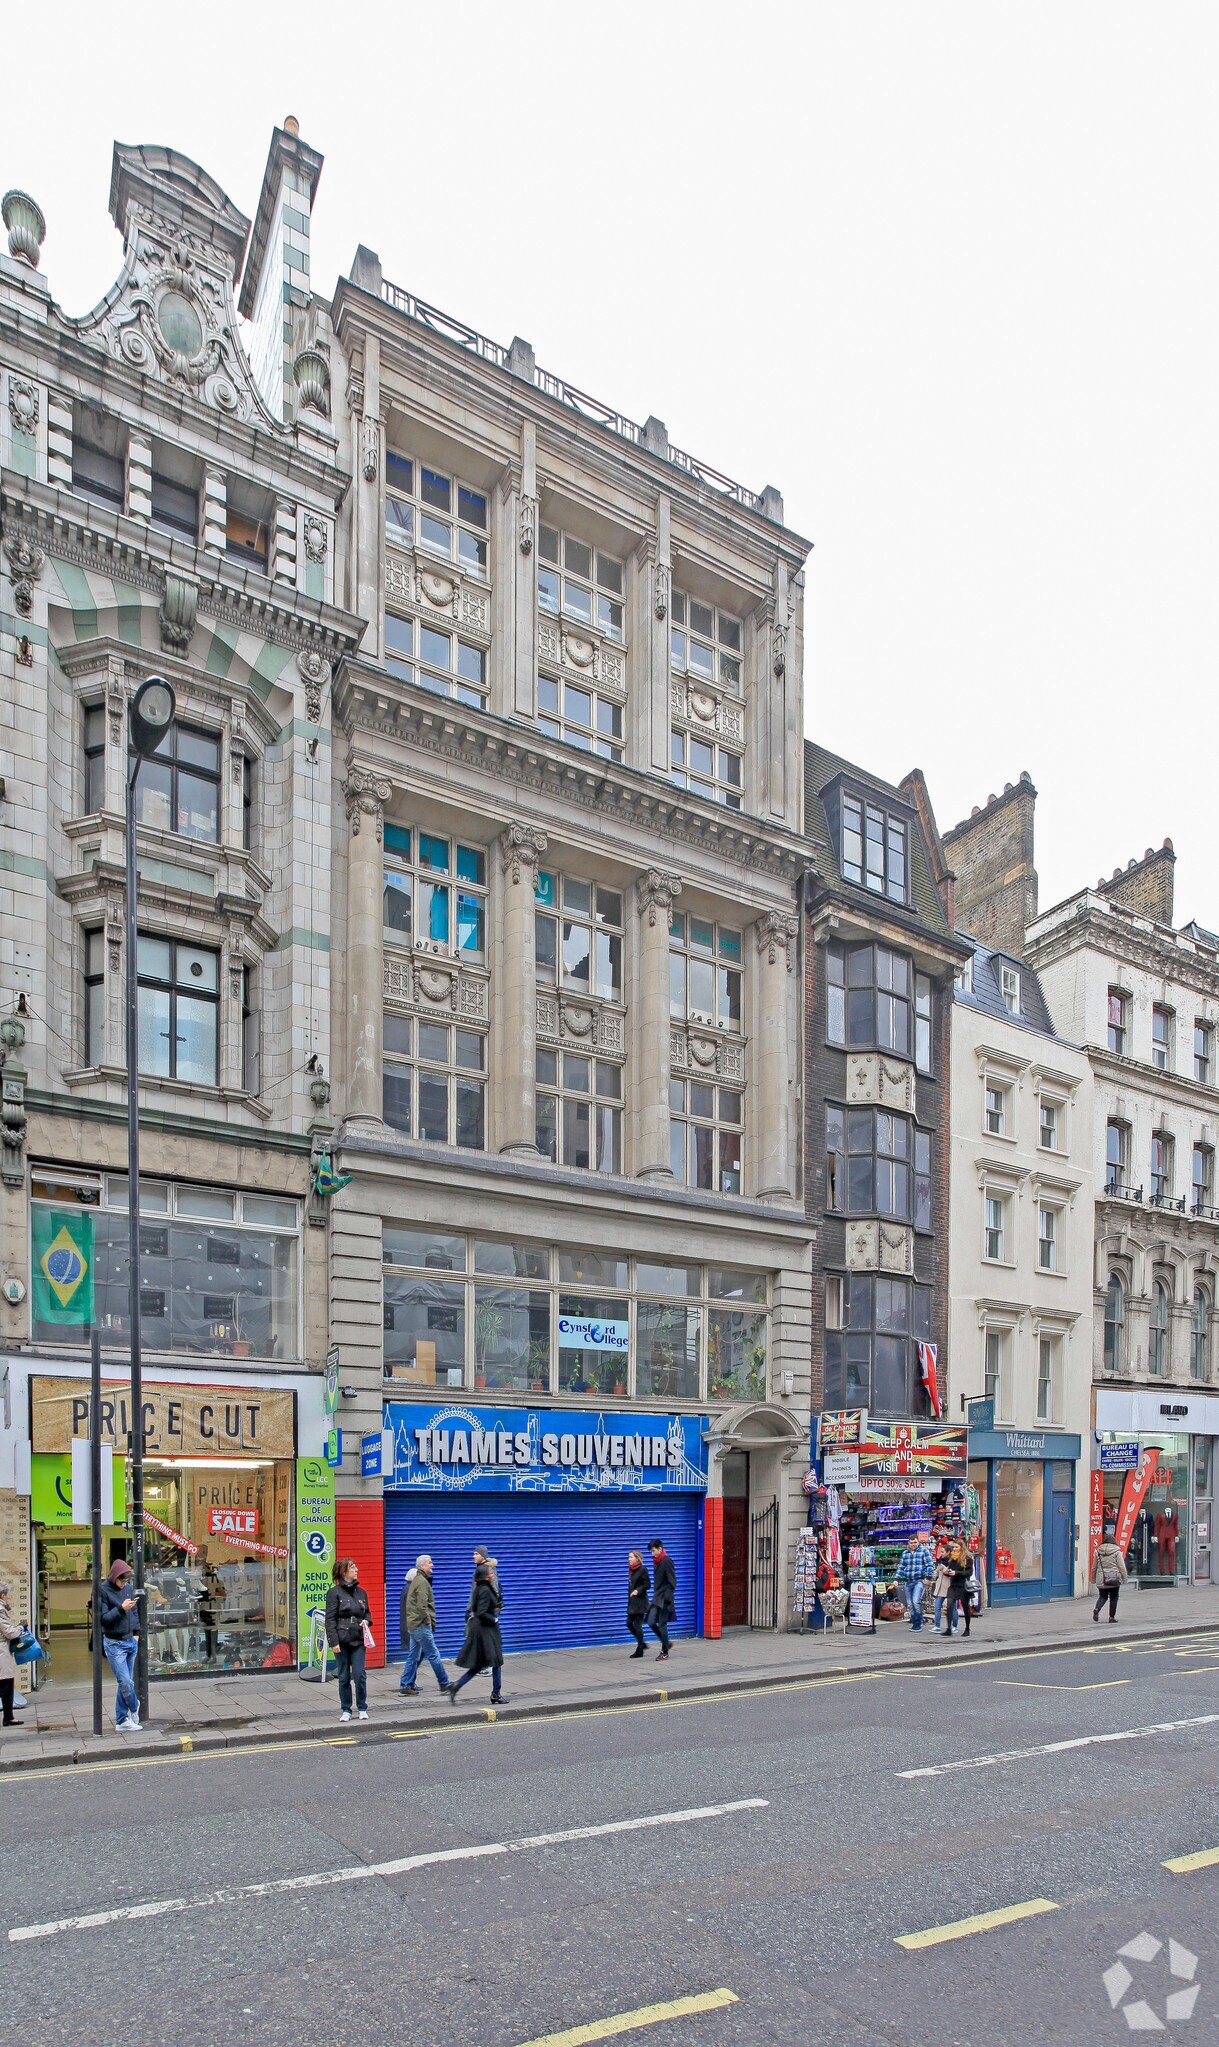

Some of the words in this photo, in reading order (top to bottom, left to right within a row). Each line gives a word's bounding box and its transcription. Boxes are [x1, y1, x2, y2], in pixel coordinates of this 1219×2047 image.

[73, 1400, 181, 1436] PRICE
[200, 1405, 260, 1438] CUT
[878, 1438, 902, 1449] KEEP
[904, 1439, 929, 1450] CALM
[1006, 1433, 1045, 1448] Whittard
[415, 1429, 530, 1464] THAMES
[542, 1433, 683, 1467] SOUVENIRS
[895, 1450, 913, 1460] AND
[366, 1458, 377, 1469] ZONE
[877, 1461, 900, 1472] VISIT
[906, 1462, 913, 1472] H
[916, 1463, 922, 1472] &
[923, 1464, 930, 1473] Z
[861, 1479, 884, 1488] UPTO
[886, 1479, 902, 1488] 50%
[905, 1480, 925, 1488] SALE
[199, 1486, 253, 1505] PRICE
[211, 1515, 255, 1532] SALE
[143, 1510, 172, 1536] VERYTHING
[172, 1532, 188, 1547] MUST
[187, 1543, 198, 1554] GO
[1090, 1526, 1102, 1536] £99
[225, 1535, 260, 1550] EVERYTHING
[261, 1544, 277, 1554] MUST
[305, 1572, 328, 1581] SEND
[301, 1583, 333, 1592] MONEY
